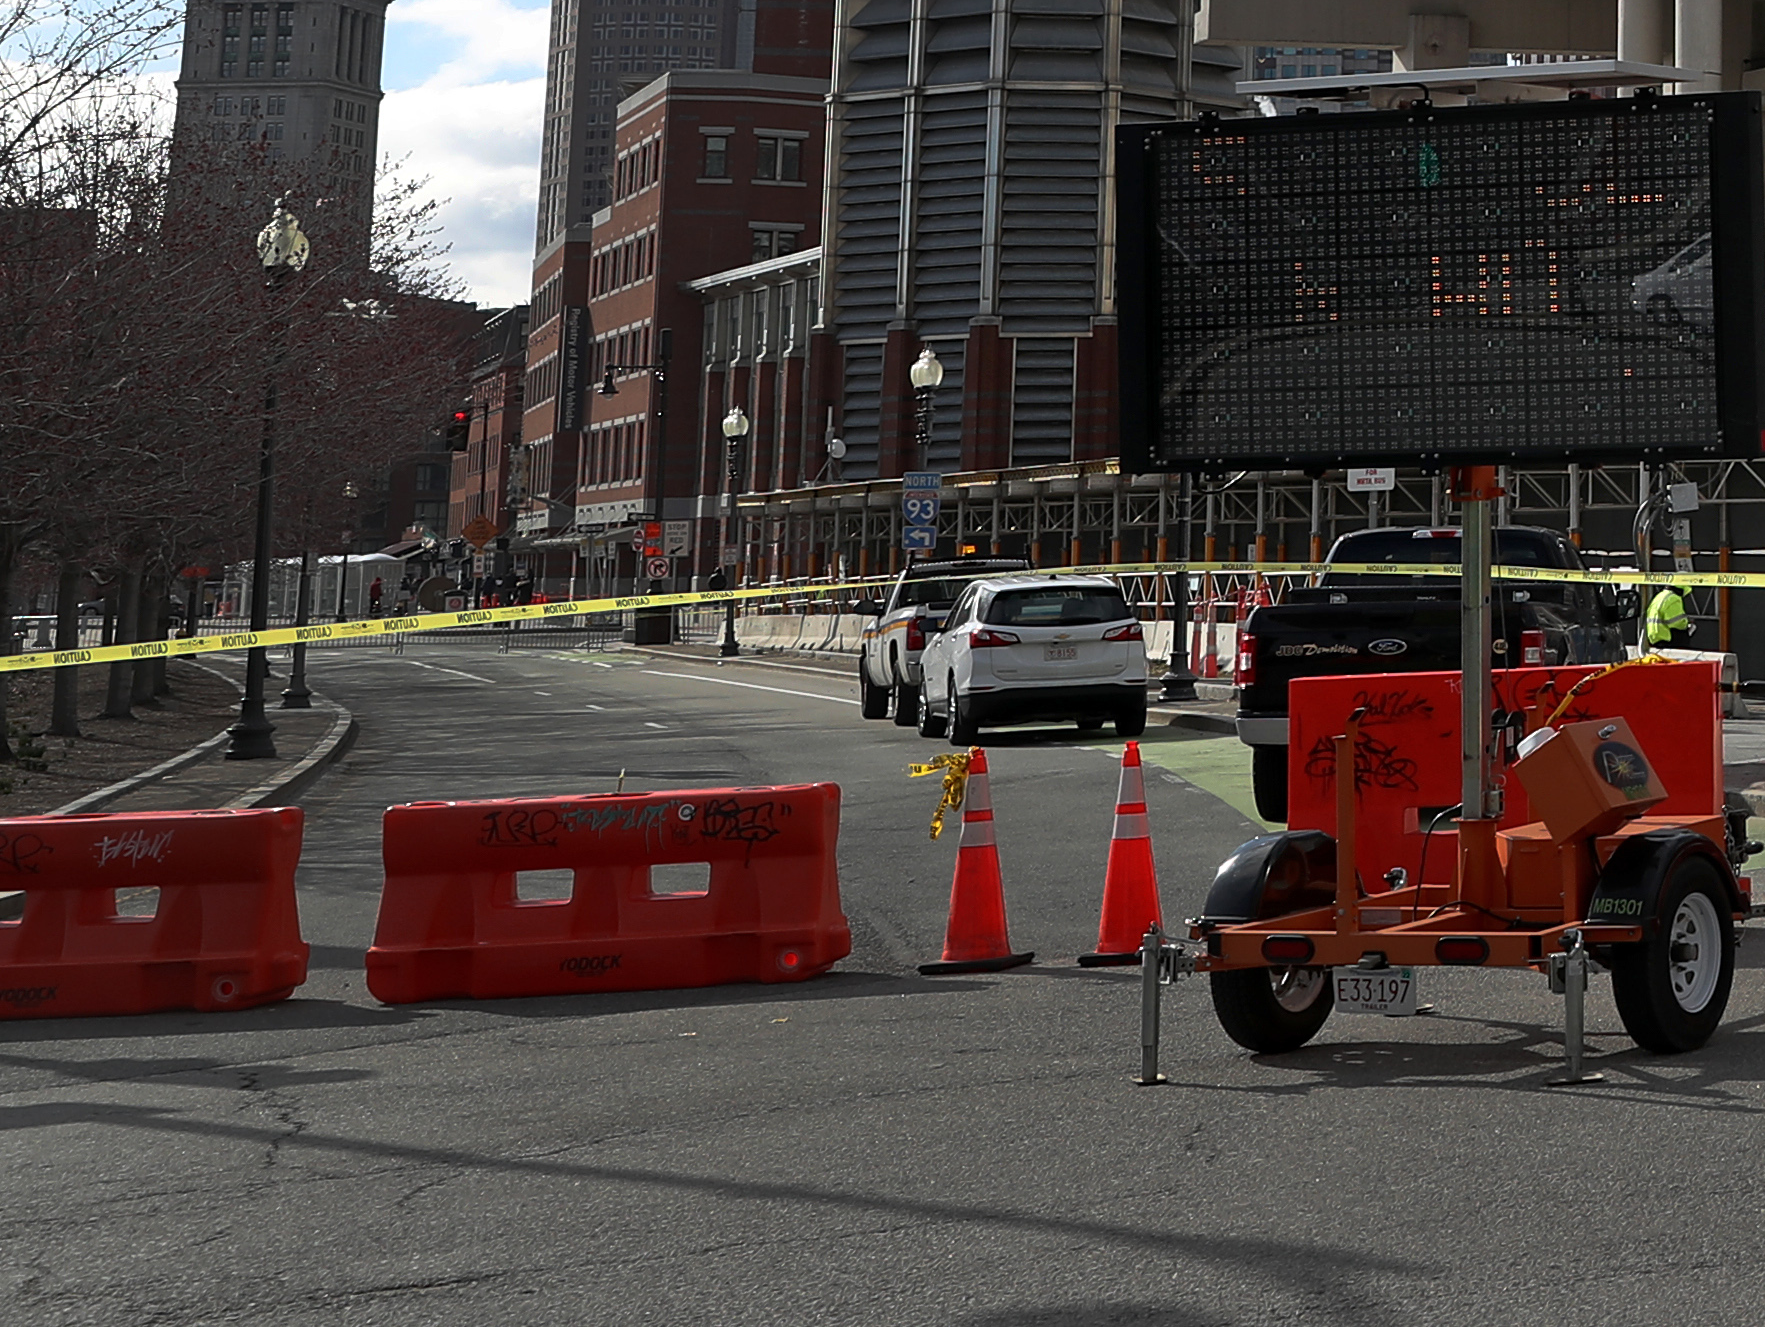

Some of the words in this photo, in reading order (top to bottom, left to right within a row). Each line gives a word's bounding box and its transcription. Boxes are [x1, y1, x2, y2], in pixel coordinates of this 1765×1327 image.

[571, 308, 581, 345] Registry
[569, 347, 576, 356] of
[568, 358, 577, 389] Motor
[564, 390, 576, 429] Vehicles
[905, 476, 940, 486] NORTH
[907, 499, 934, 519] 93
[1507, 567, 1539, 578] CAUTION
[1582, 569, 1613, 581] CAUTION
[1644, 571, 1674, 583] CAUTION
[1716, 573, 1747, 585] CAUTION
[1303, 643, 1358, 656] Demolition
[1376, 642, 1399, 652] Ford
[1593, 897, 1643, 915] MB1301
[559, 954, 622, 972] YODOCK
